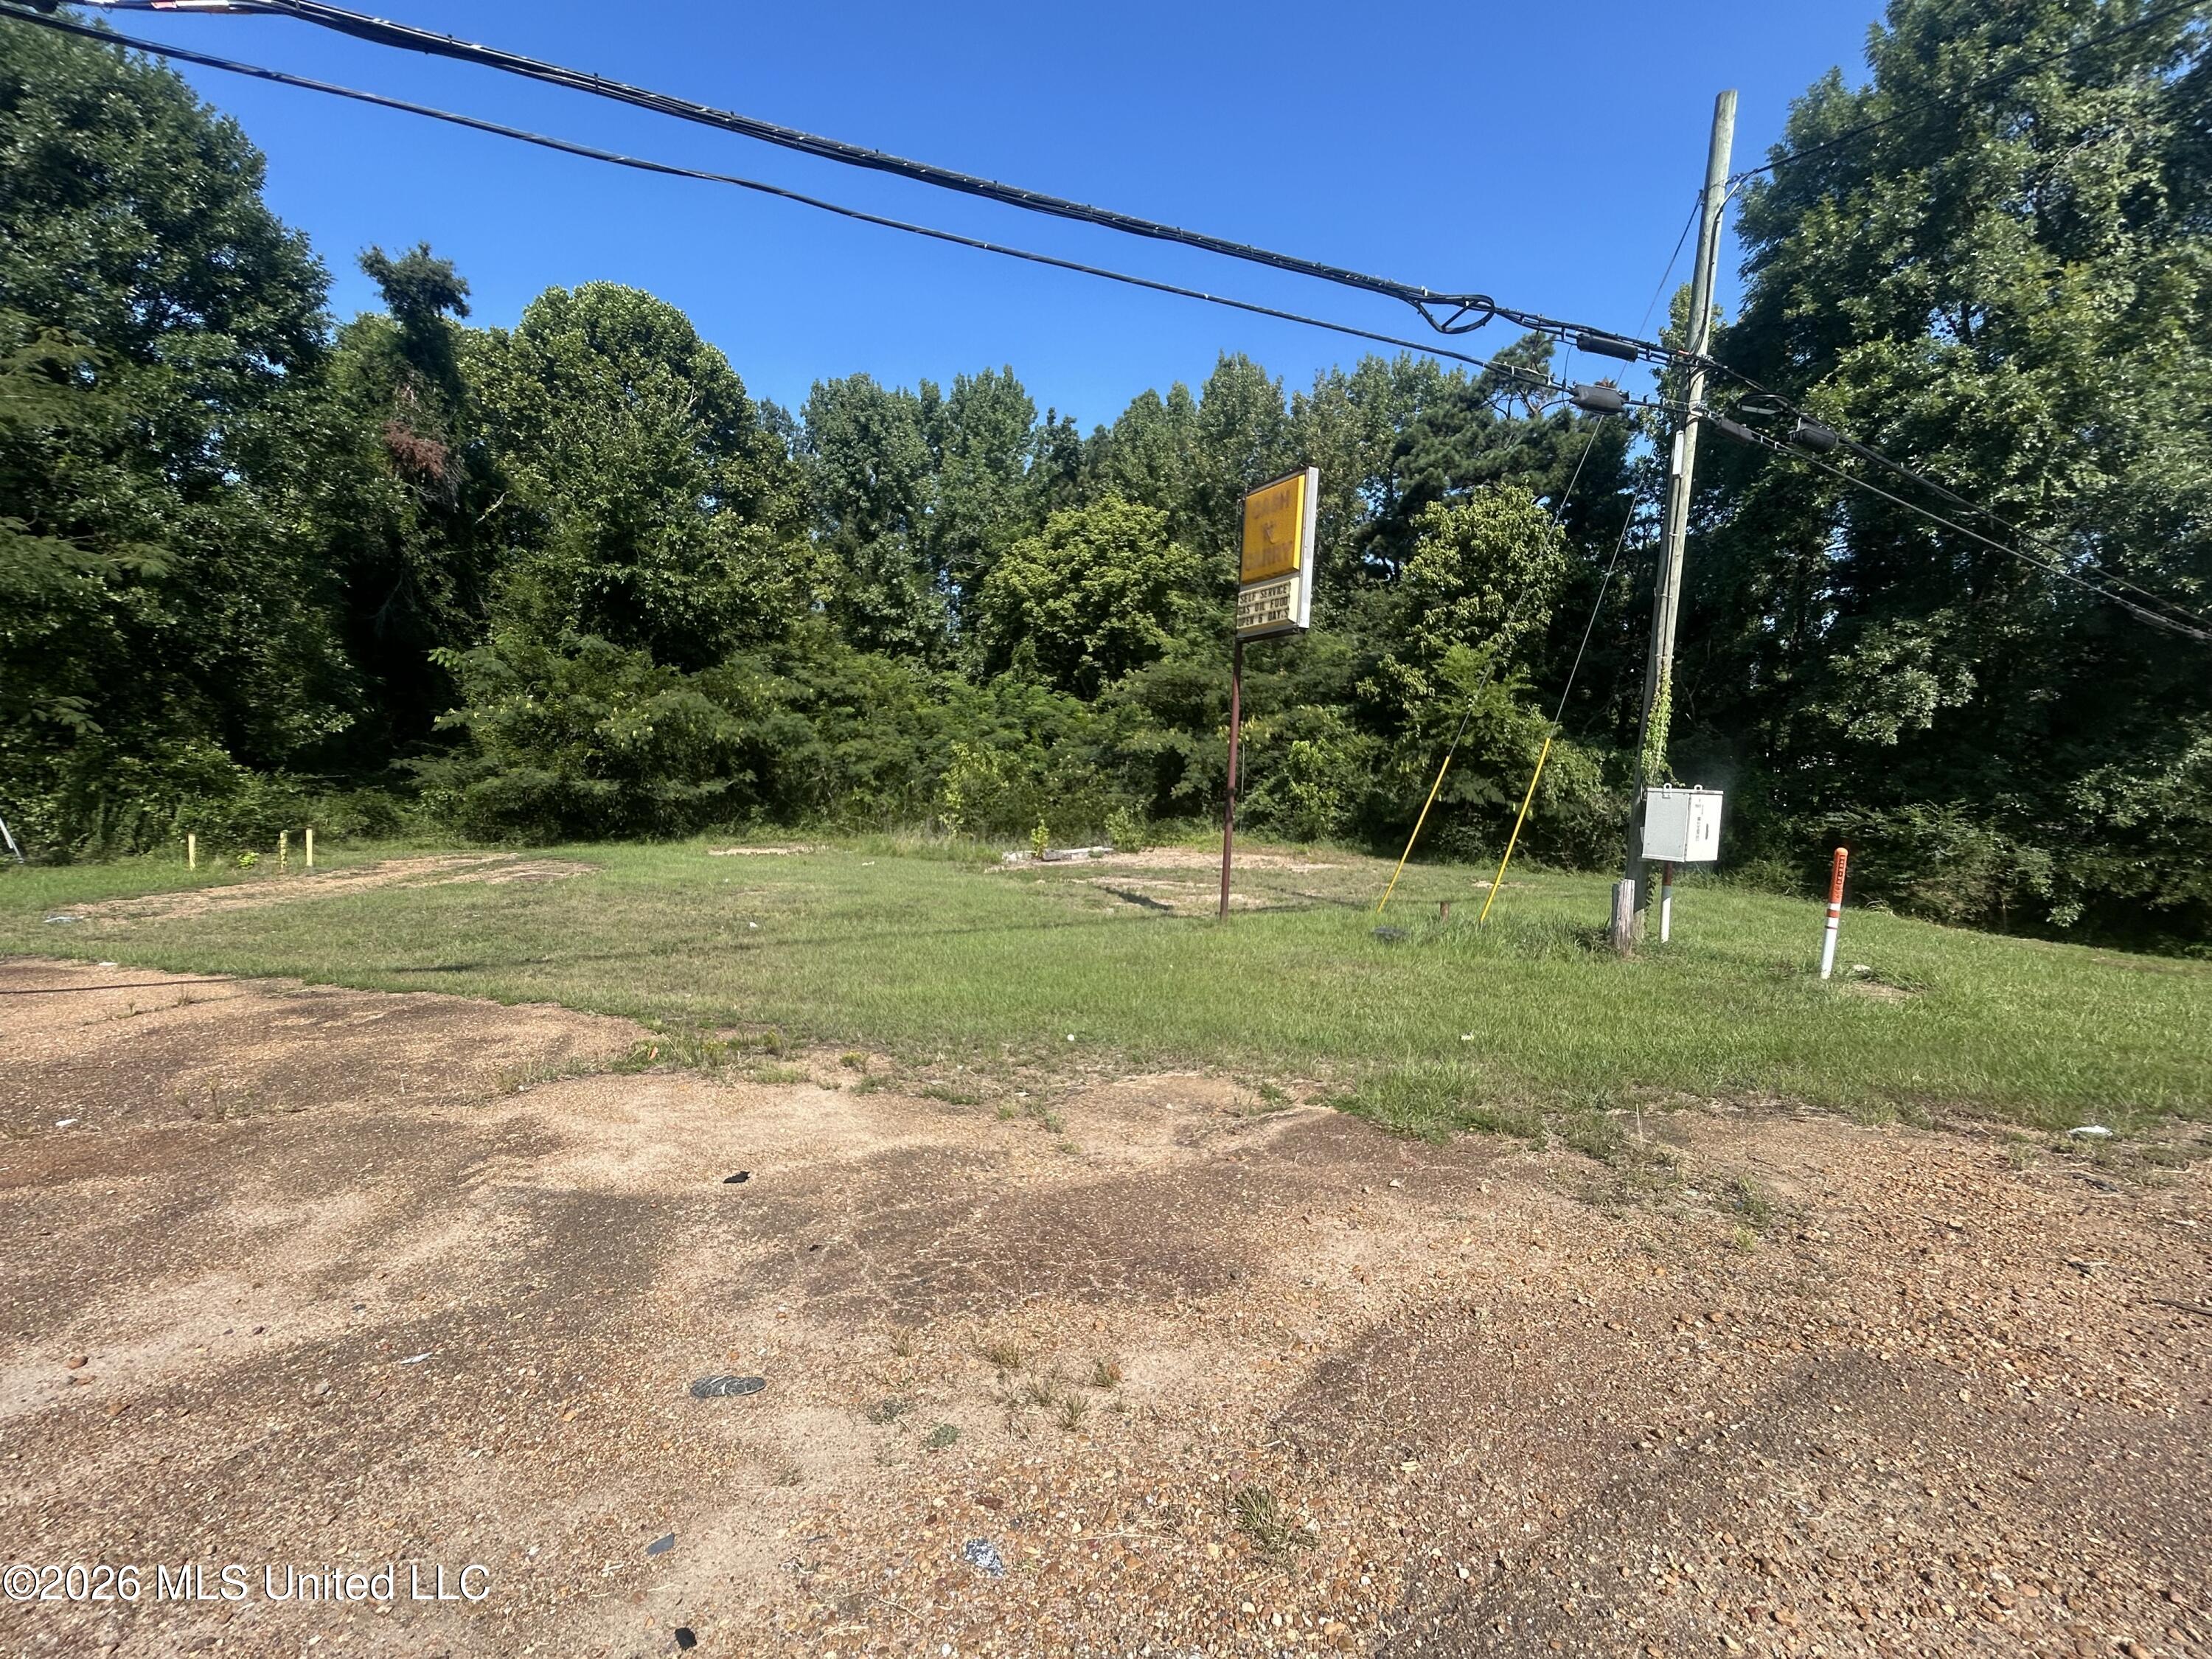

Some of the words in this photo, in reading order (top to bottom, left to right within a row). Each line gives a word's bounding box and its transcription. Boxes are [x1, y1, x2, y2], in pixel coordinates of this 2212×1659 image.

[1240, 591, 1256, 604] SELF
[1260, 585, 1287, 599] SERVICE
[1239, 605, 1251, 616] GAS
[1255, 602, 1265, 612] OIL
[1270, 596, 1288, 609] FOOD
[1238, 615, 1254, 627] OPEN
[1258, 613, 1263, 623] 6
